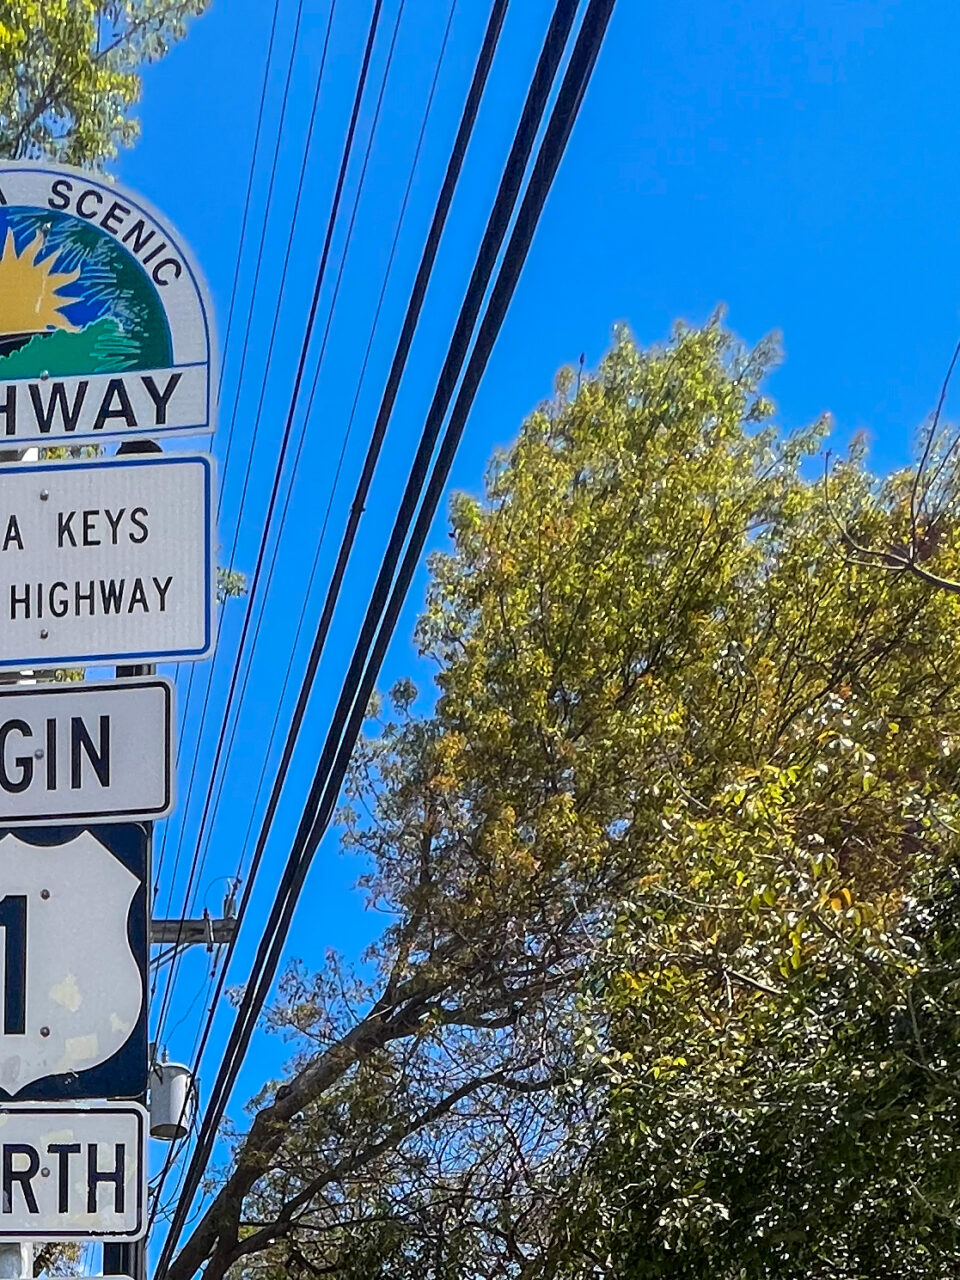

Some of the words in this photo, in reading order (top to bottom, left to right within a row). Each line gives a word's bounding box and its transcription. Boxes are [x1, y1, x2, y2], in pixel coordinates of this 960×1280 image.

[48, 179, 182, 286] SCENIC
[57, 507, 149, 548] KEYS
[10, 576, 173, 620] HIGHWAY
